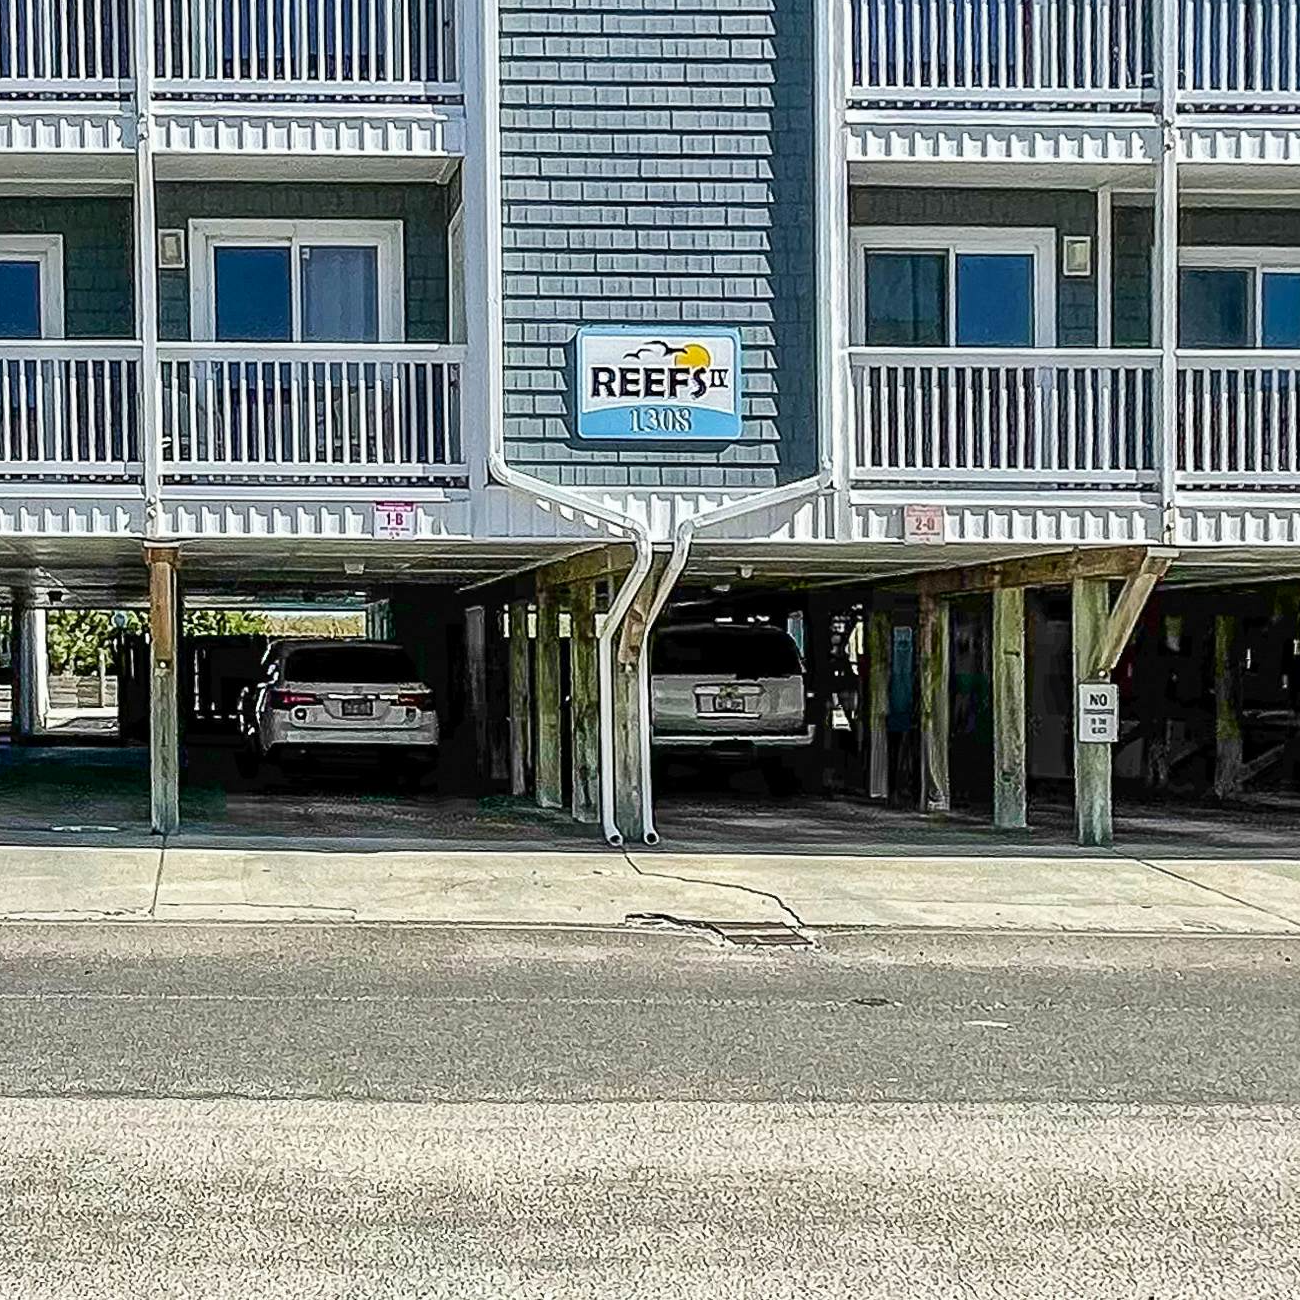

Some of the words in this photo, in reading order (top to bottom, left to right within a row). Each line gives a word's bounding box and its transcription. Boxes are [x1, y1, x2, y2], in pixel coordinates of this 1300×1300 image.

[590, 365, 708, 399] REEFS
[709, 368, 730, 389] IV
[629, 406, 693, 433] 1308
[386, 512, 404, 526] 1-B
[1089, 693, 1109, 707] NO
